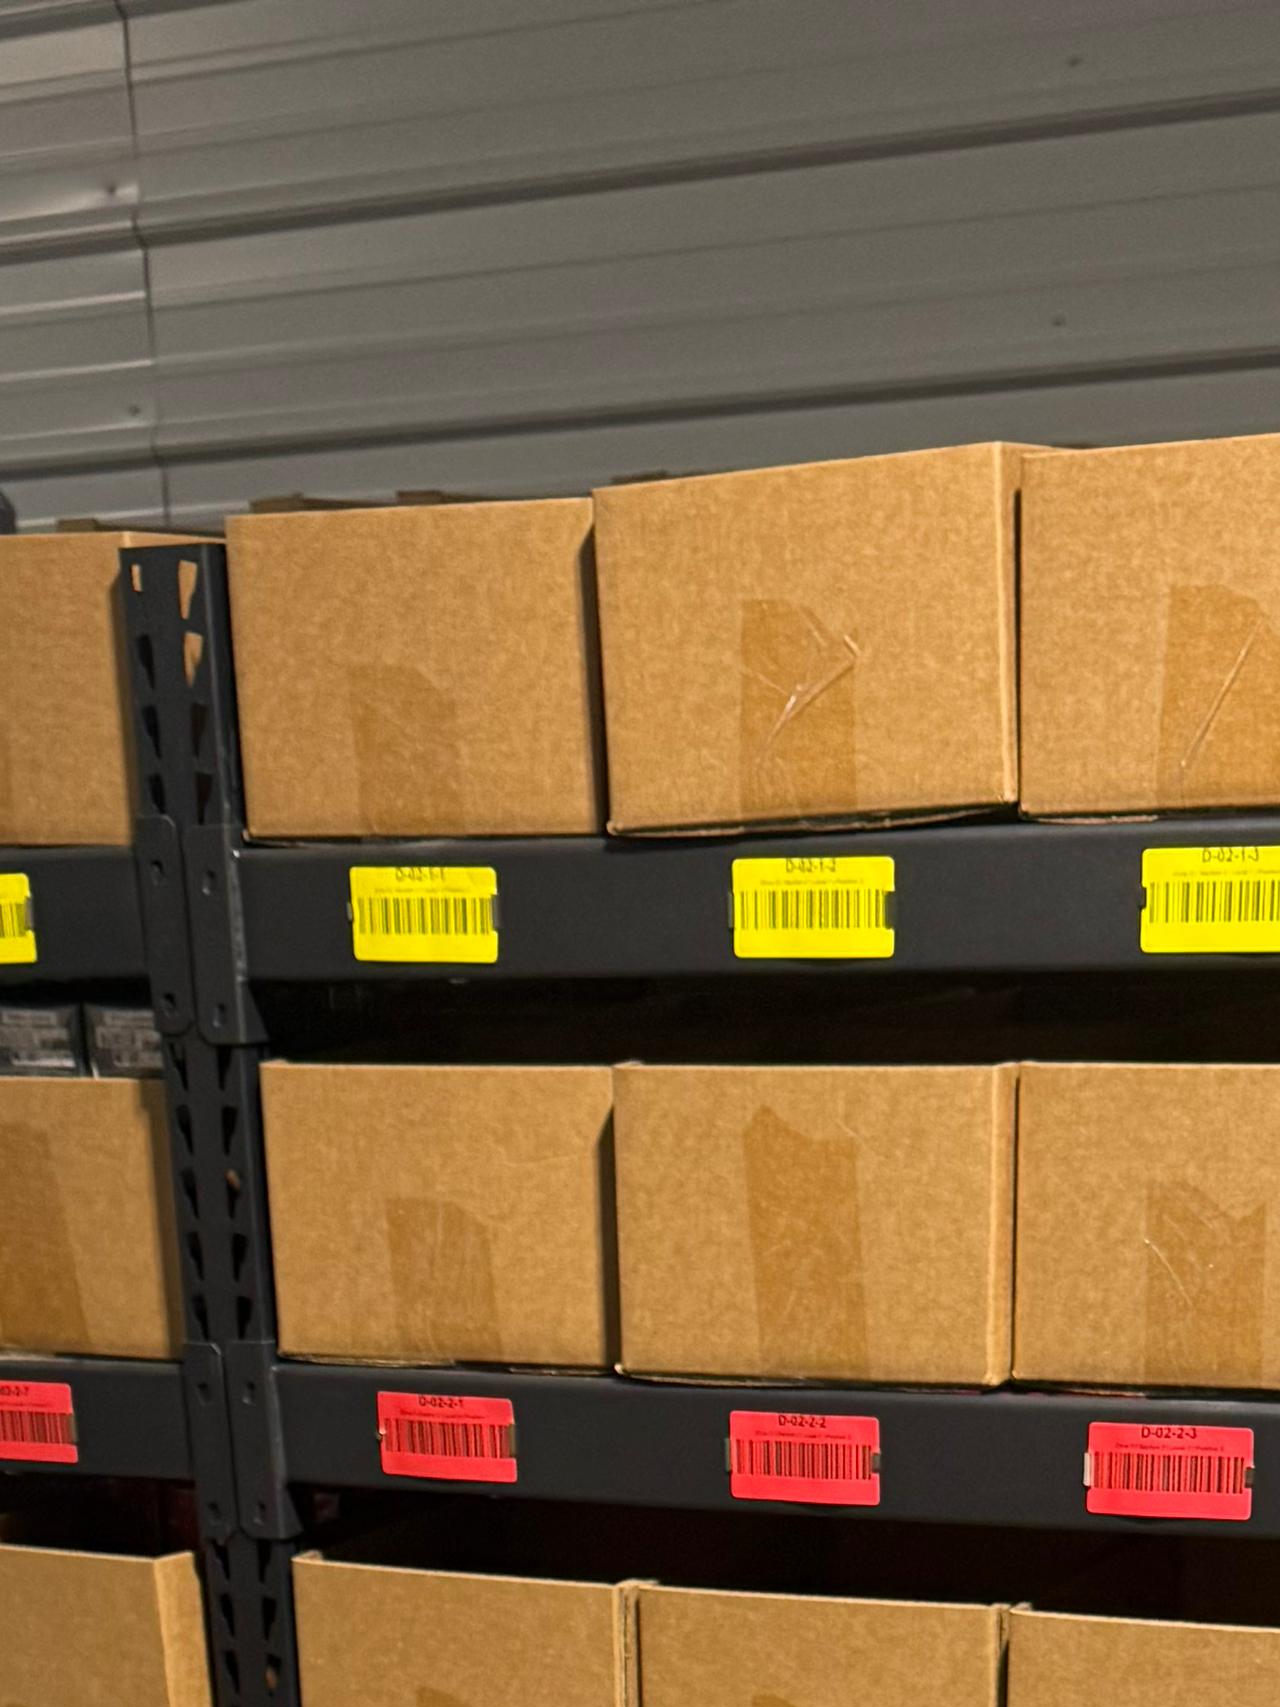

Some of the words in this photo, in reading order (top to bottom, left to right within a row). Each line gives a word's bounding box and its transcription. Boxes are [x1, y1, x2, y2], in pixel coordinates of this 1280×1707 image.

[418, 1395, 464, 1409] D-02-2-1
[778, 1414, 827, 1429] D-02-2-2
[1141, 1426, 1198, 1440] D-02-2-3
